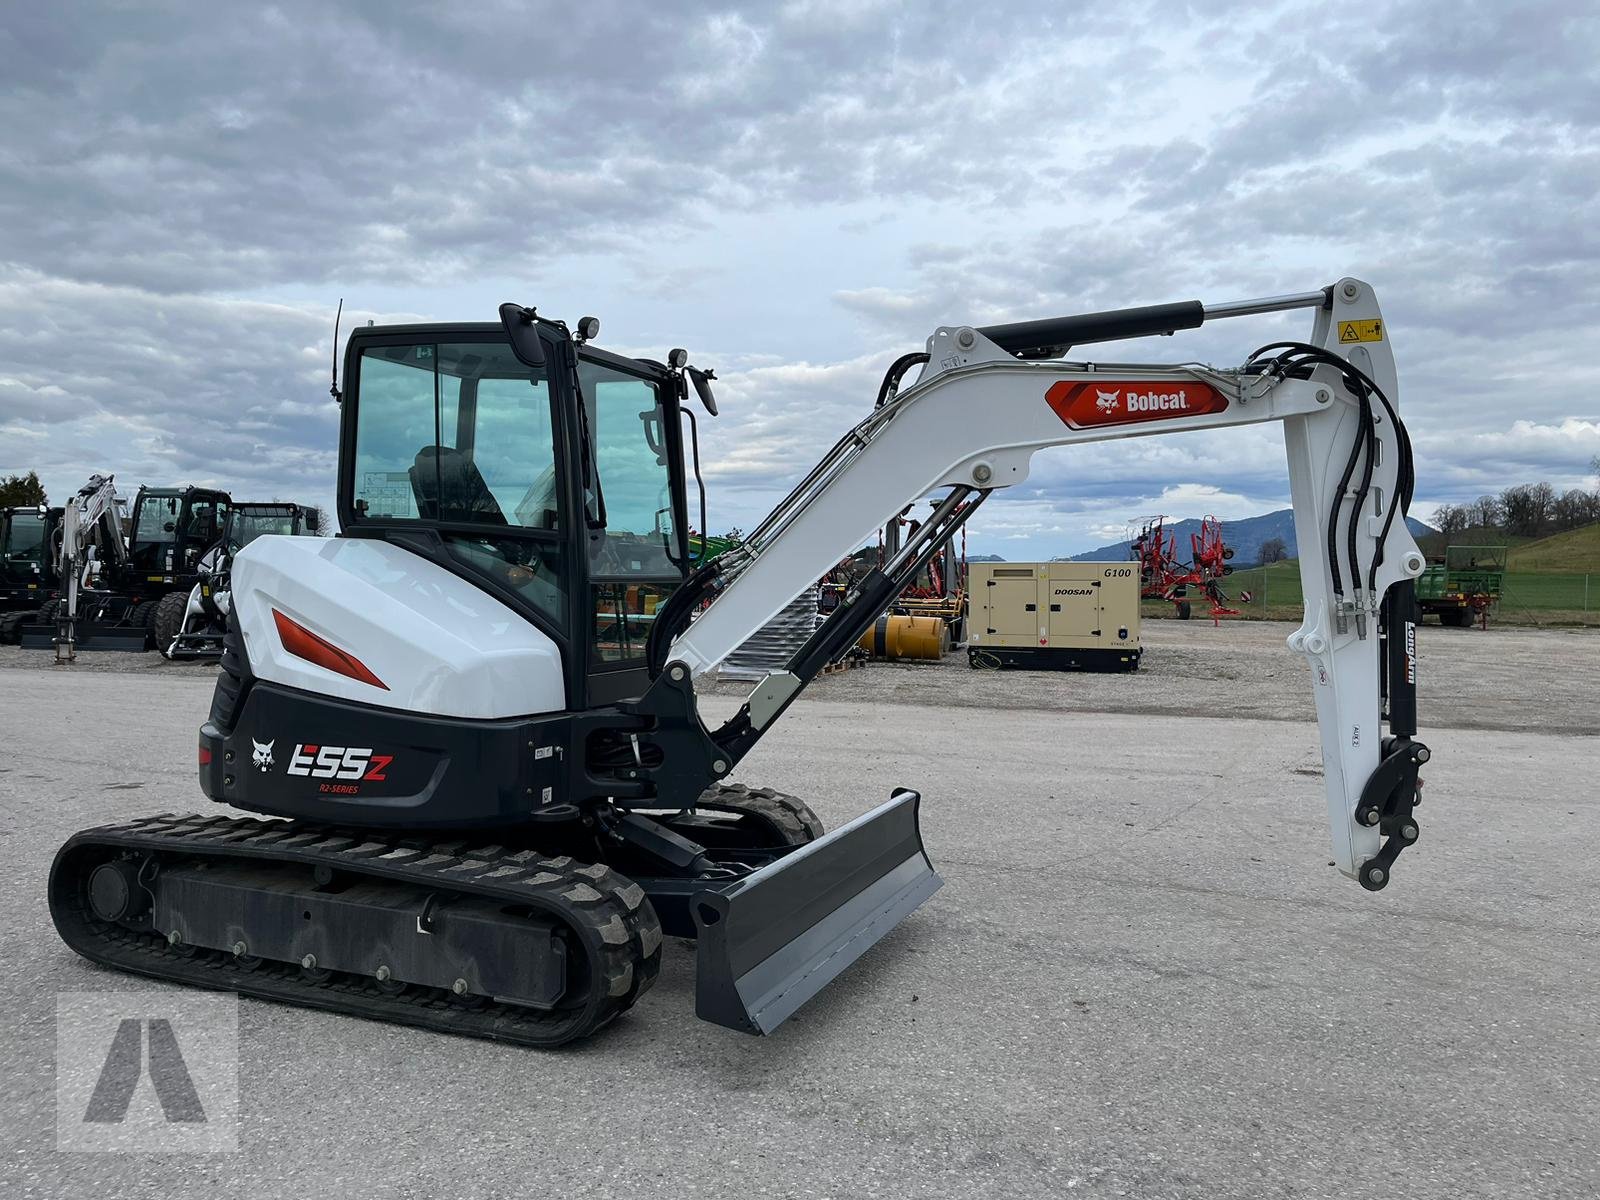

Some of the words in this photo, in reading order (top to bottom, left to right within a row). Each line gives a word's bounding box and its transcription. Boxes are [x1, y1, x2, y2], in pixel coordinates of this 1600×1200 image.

[1127, 391, 1186, 411] Bobcat
[1104, 569, 1131, 577] G100
[1405, 621, 1415, 684] LongArm
